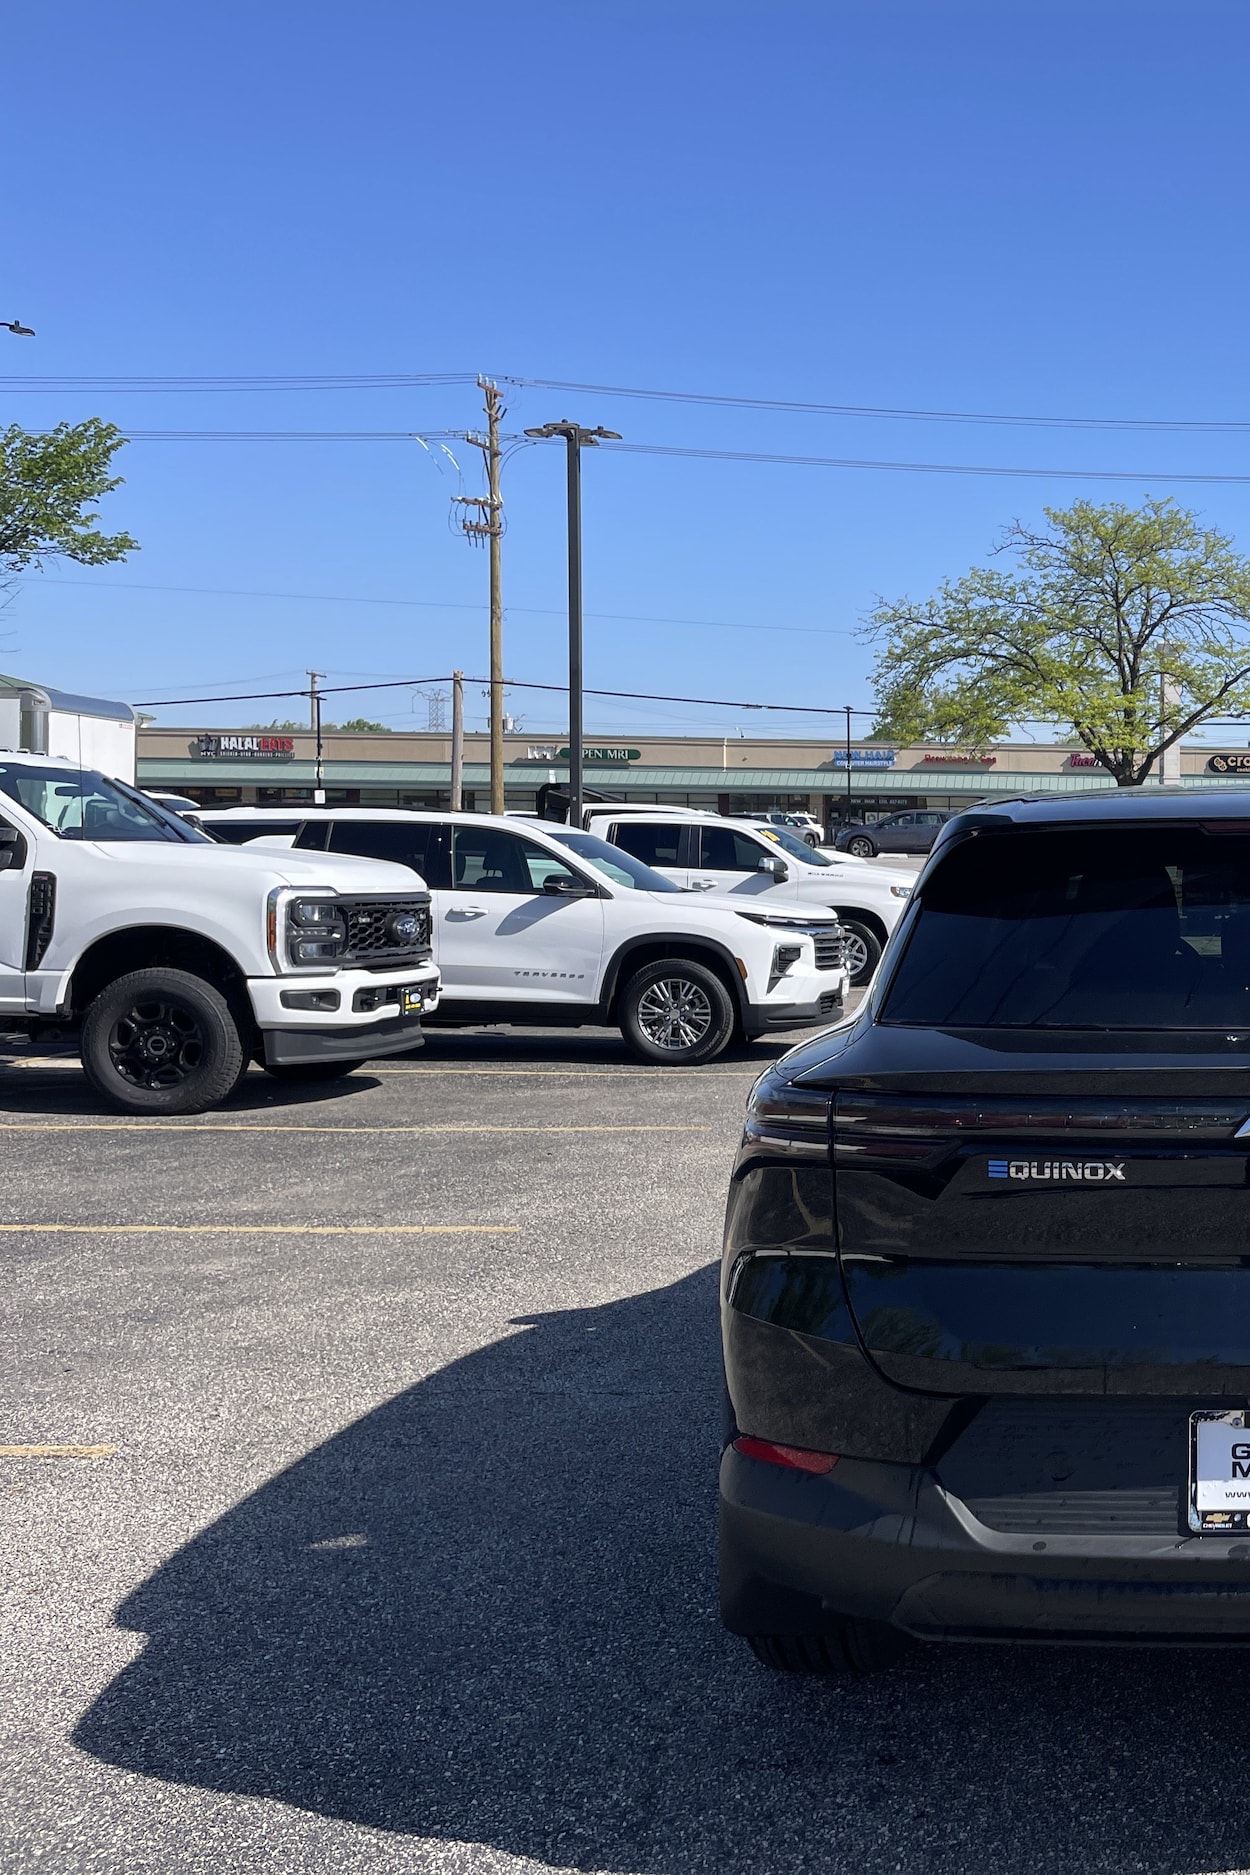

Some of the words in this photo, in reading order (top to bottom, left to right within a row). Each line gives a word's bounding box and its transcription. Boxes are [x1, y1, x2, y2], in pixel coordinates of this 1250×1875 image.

[220, 736, 259, 750] HALAL
[260, 737, 294, 751] EATS
[580, 749, 603, 759] PEN
[607, 750, 629, 760] MRI
[833, 750, 861, 760] NEW
[865, 750, 895, 760] HAIR
[988, 1160, 1126, 1180] EQUINOX
